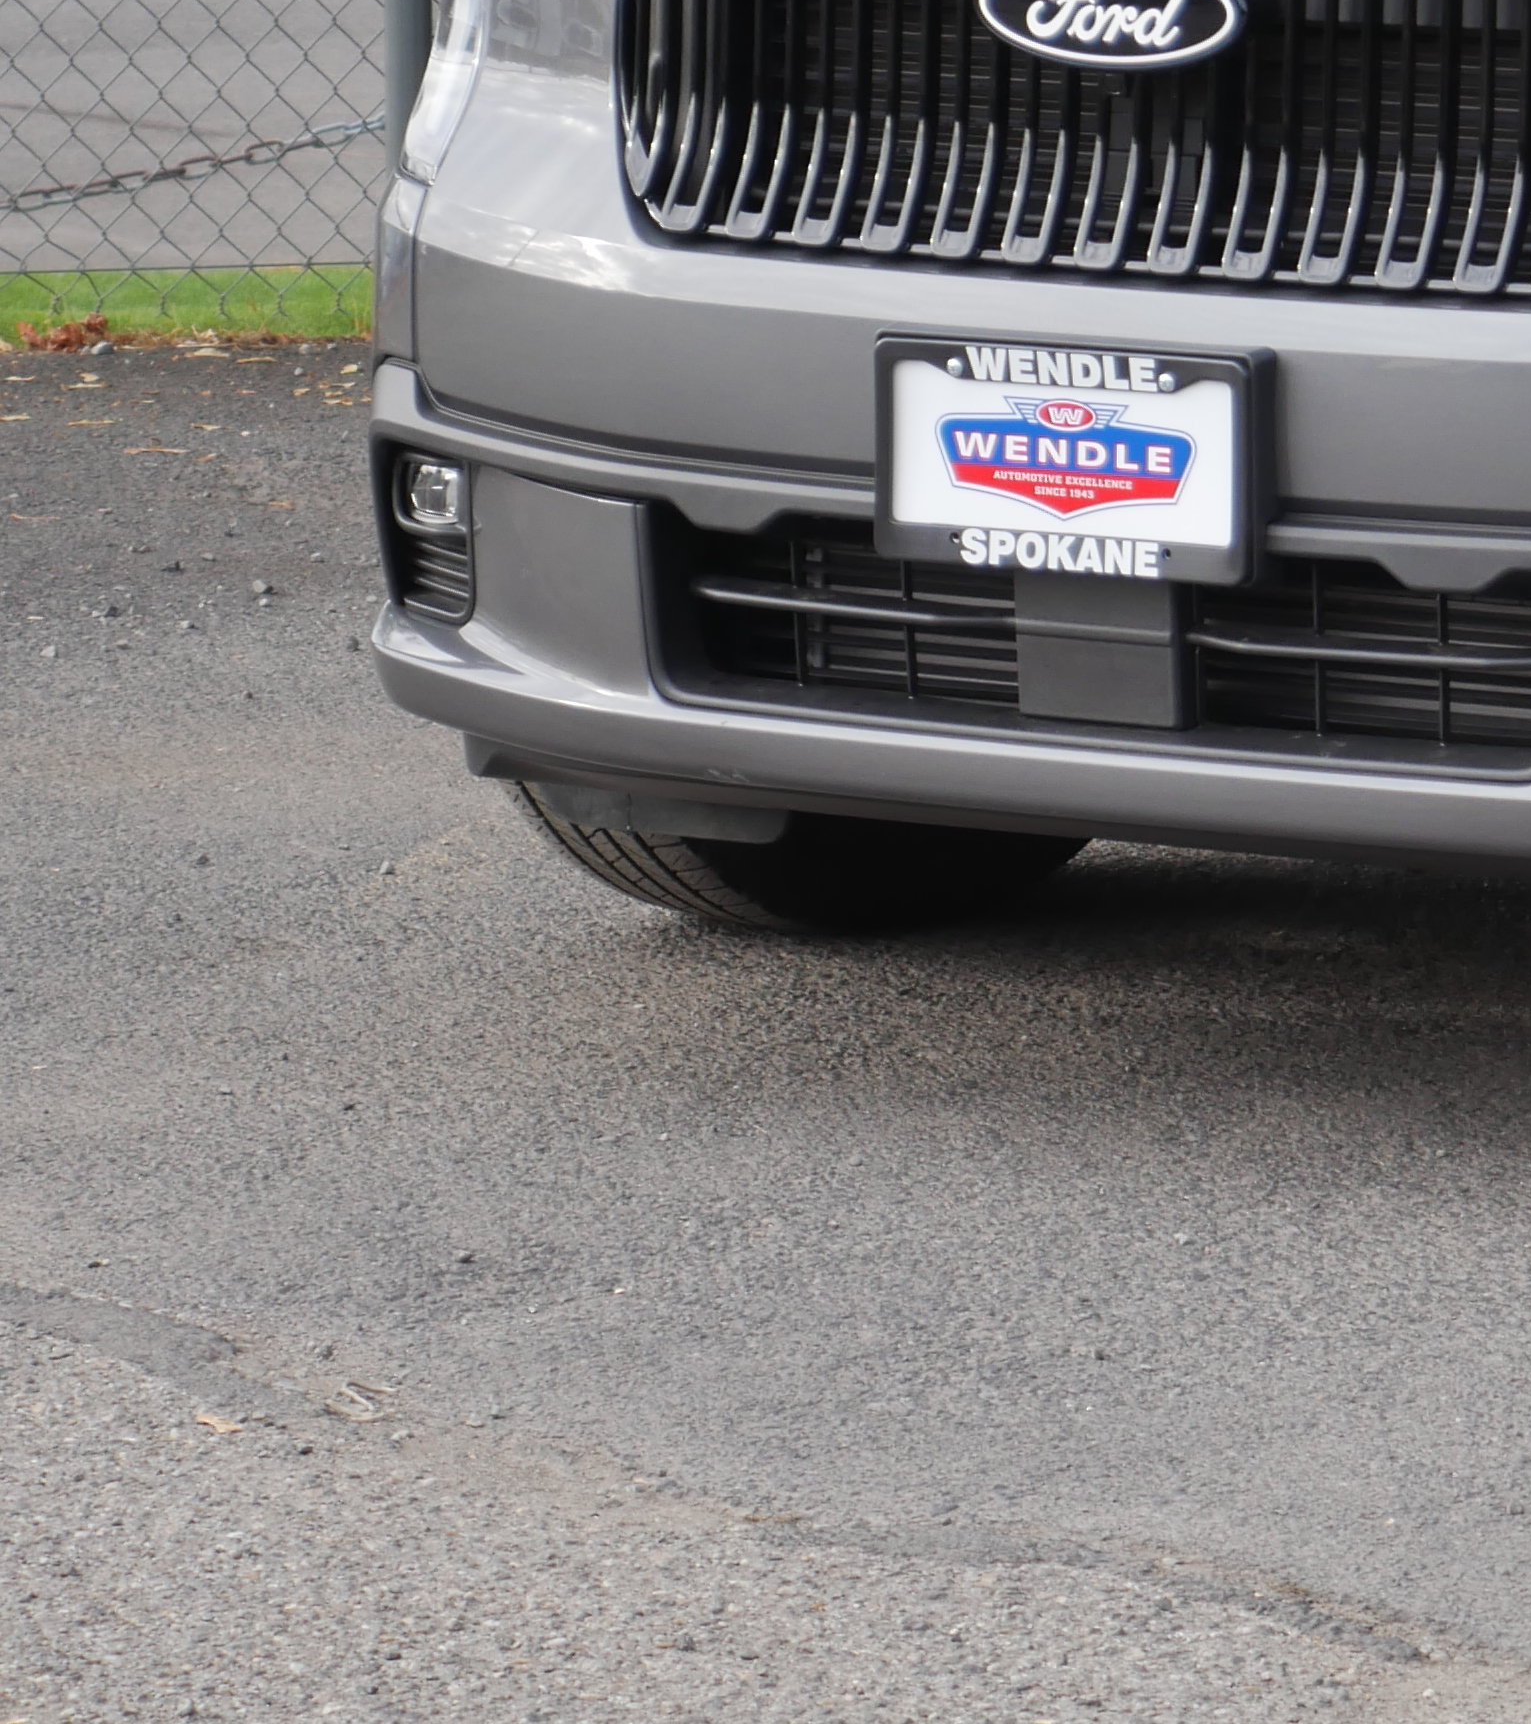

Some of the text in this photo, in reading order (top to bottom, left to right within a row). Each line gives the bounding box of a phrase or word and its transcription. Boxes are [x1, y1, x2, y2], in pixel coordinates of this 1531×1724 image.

[965, 345, 1159, 393] WENDLE
[953, 430, 1172, 473] WENDLE
[993, 470, 1133, 491] AUTOMOTIVE EXCELLENCE
[1034, 485, 1095, 500] SINCE 1943
[959, 527, 1159, 577] SPOKANE
